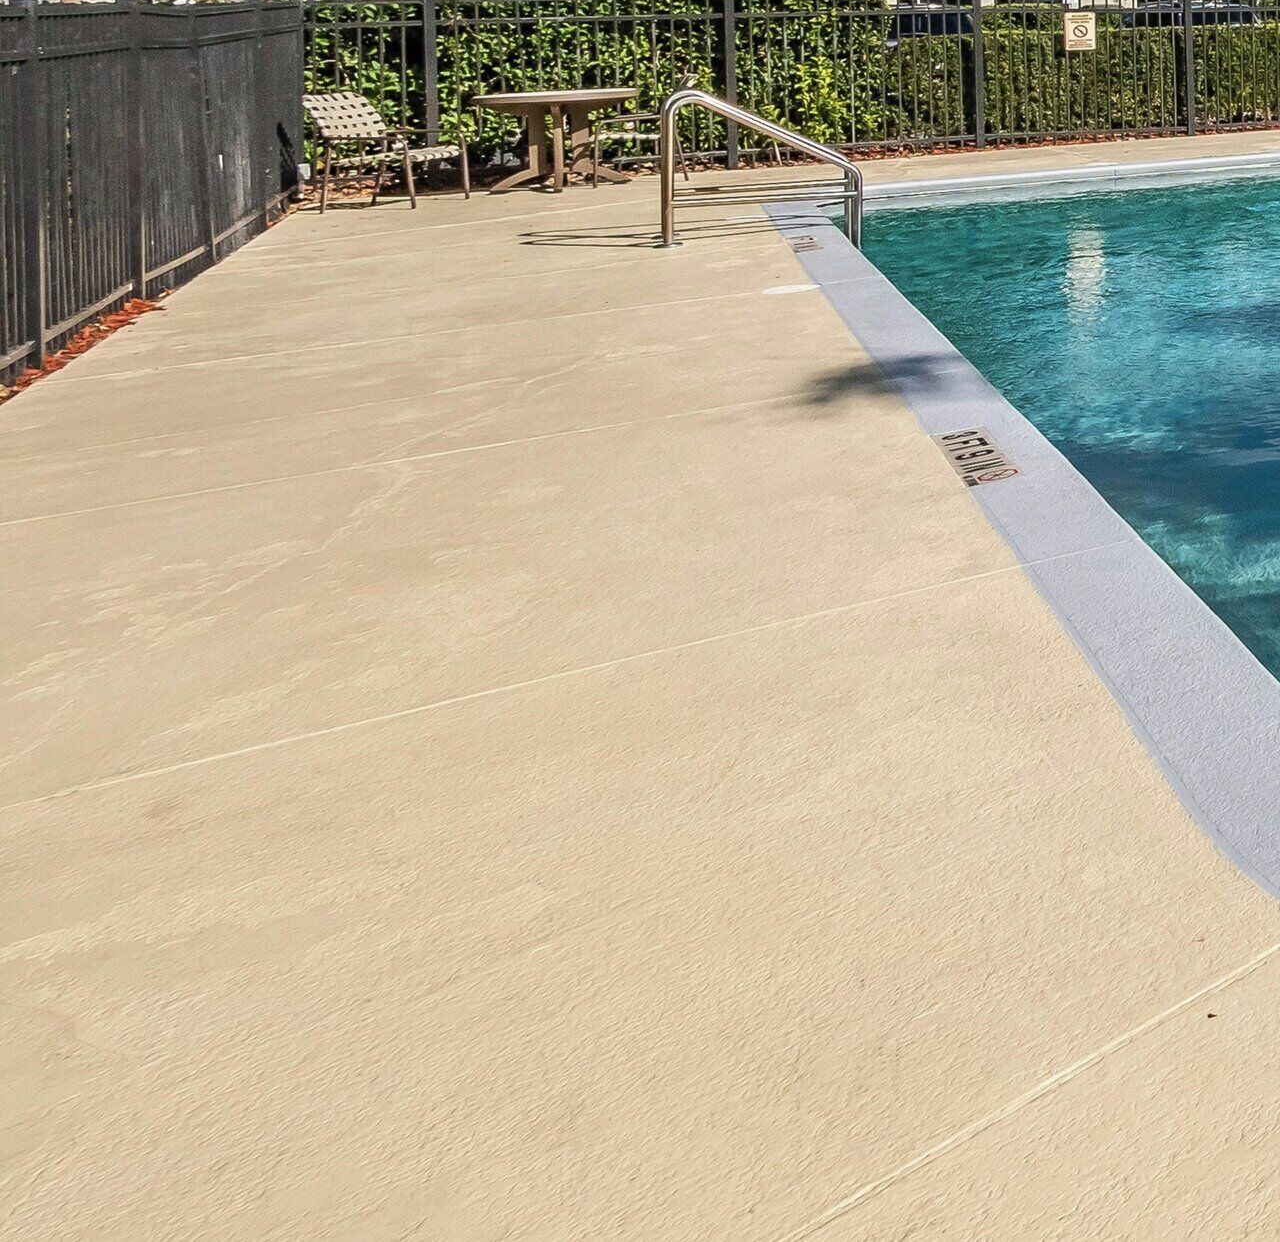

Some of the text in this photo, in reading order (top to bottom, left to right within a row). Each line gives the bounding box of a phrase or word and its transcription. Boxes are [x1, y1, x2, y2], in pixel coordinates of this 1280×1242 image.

[941, 430, 1006, 474] 3 FT 9 IN
